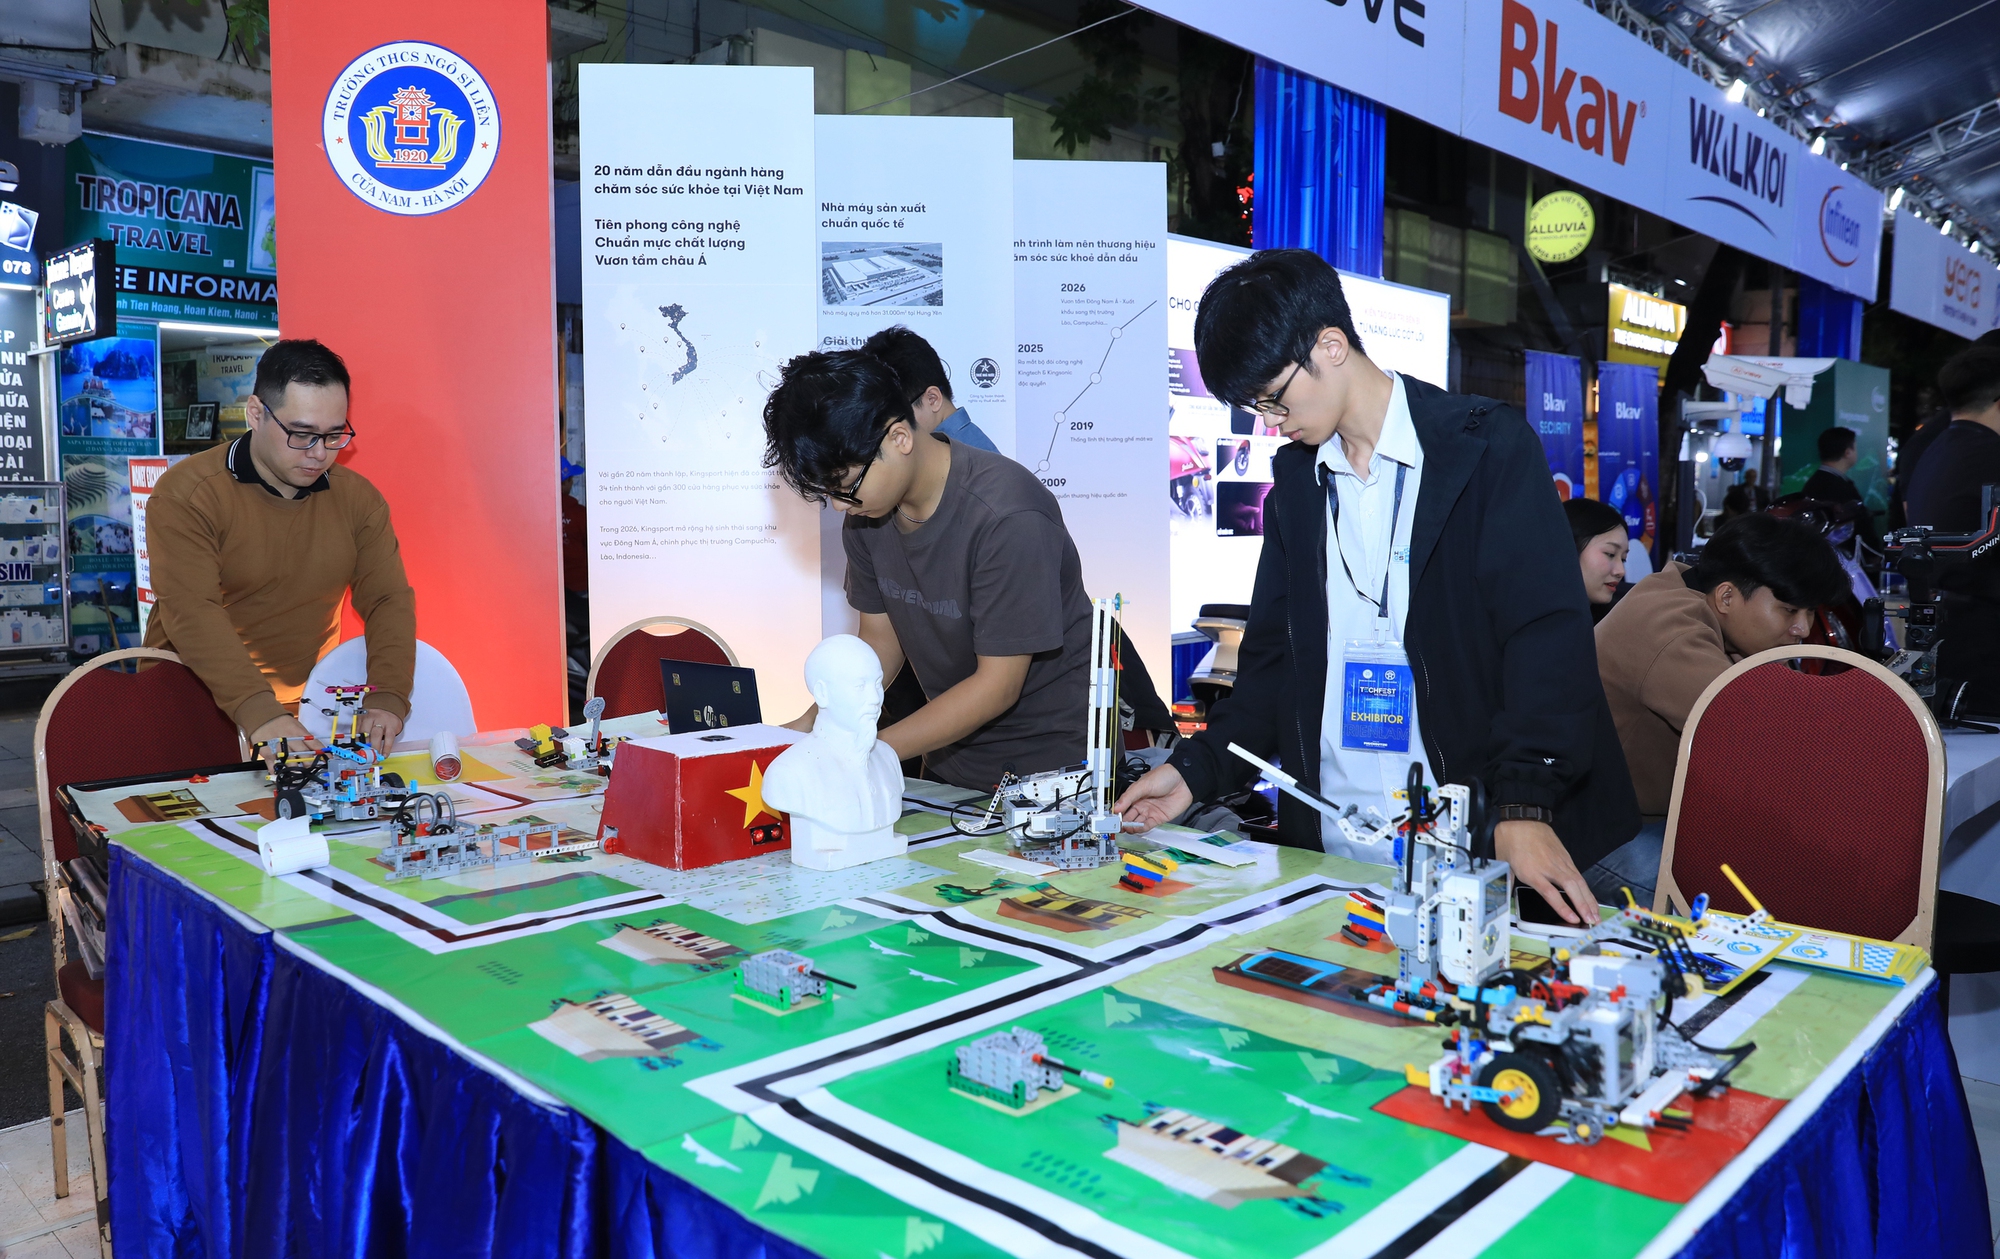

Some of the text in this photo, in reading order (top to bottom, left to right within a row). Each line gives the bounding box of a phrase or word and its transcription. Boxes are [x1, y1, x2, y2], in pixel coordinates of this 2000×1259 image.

[333, 63, 376, 121] TRƯỜNG
[376, 51, 419, 67] THCS
[424, 53, 458, 75] NGÔ
[469, 89, 490, 126] LIÊN
[1498, 0, 1638, 166] Bkav
[394, 149, 428, 162] 1920
[595, 164, 783, 180] 20 năm dẫn đầu ngành hàng
[352, 173, 376, 197] CỬA
[379, 190, 411, 207] NAM
[422, 188, 443, 207] HÀ
[444, 177, 470, 198] NỘI
[595, 183, 803, 197] chăm sóc sức khỏe tại Việt Nam
[76, 173, 243, 230] TROPICANA
[822, 203, 926, 215] Nhà máy sản xuất
[595, 219, 740, 233] Tiên phong công nghệ
[822, 217, 904, 230] chuẩn quốc tế
[1529, 222, 1587, 234] ALLUVIA
[108, 222, 212, 256] TRAVEL
[595, 235, 745, 251] Chuẩn mực chất lượng
[1028, 239, 1052, 247] trình
[1055, 239, 1073, 247] làm
[1076, 240, 1094, 248] nên
[1097, 240, 1132, 250] thương
[1135, 240, 1155, 250] hiệu
[595, 252, 707, 265] Vươn tầm châu Á
[2, 259, 32, 275] 078
[149, 269, 279, 302] INFORMA
[1061, 283, 1086, 292] 2026
[130, 300, 149, 311] Tien
[151, 302, 181, 315] Hoang,
[184, 303, 205, 315] Hoan
[208, 305, 232, 318] Kiem,
[234, 308, 258, 320] Hanoi
[1018, 344, 1043, 353] 2025
[221, 365, 244, 375] TRAVEL
[1543, 392, 1566, 412] Bkav
[1615, 402, 1641, 419] Bkav
[1071, 422, 1093, 430] 2019
[1540, 421, 1571, 435] SECURITY
[1041, 478, 1066, 488] 2009
[1972, 534, 2000, 558] RONIN
[0, 562, 32, 582] SIM
[1351, 712, 1404, 724] EXHIBITOR
